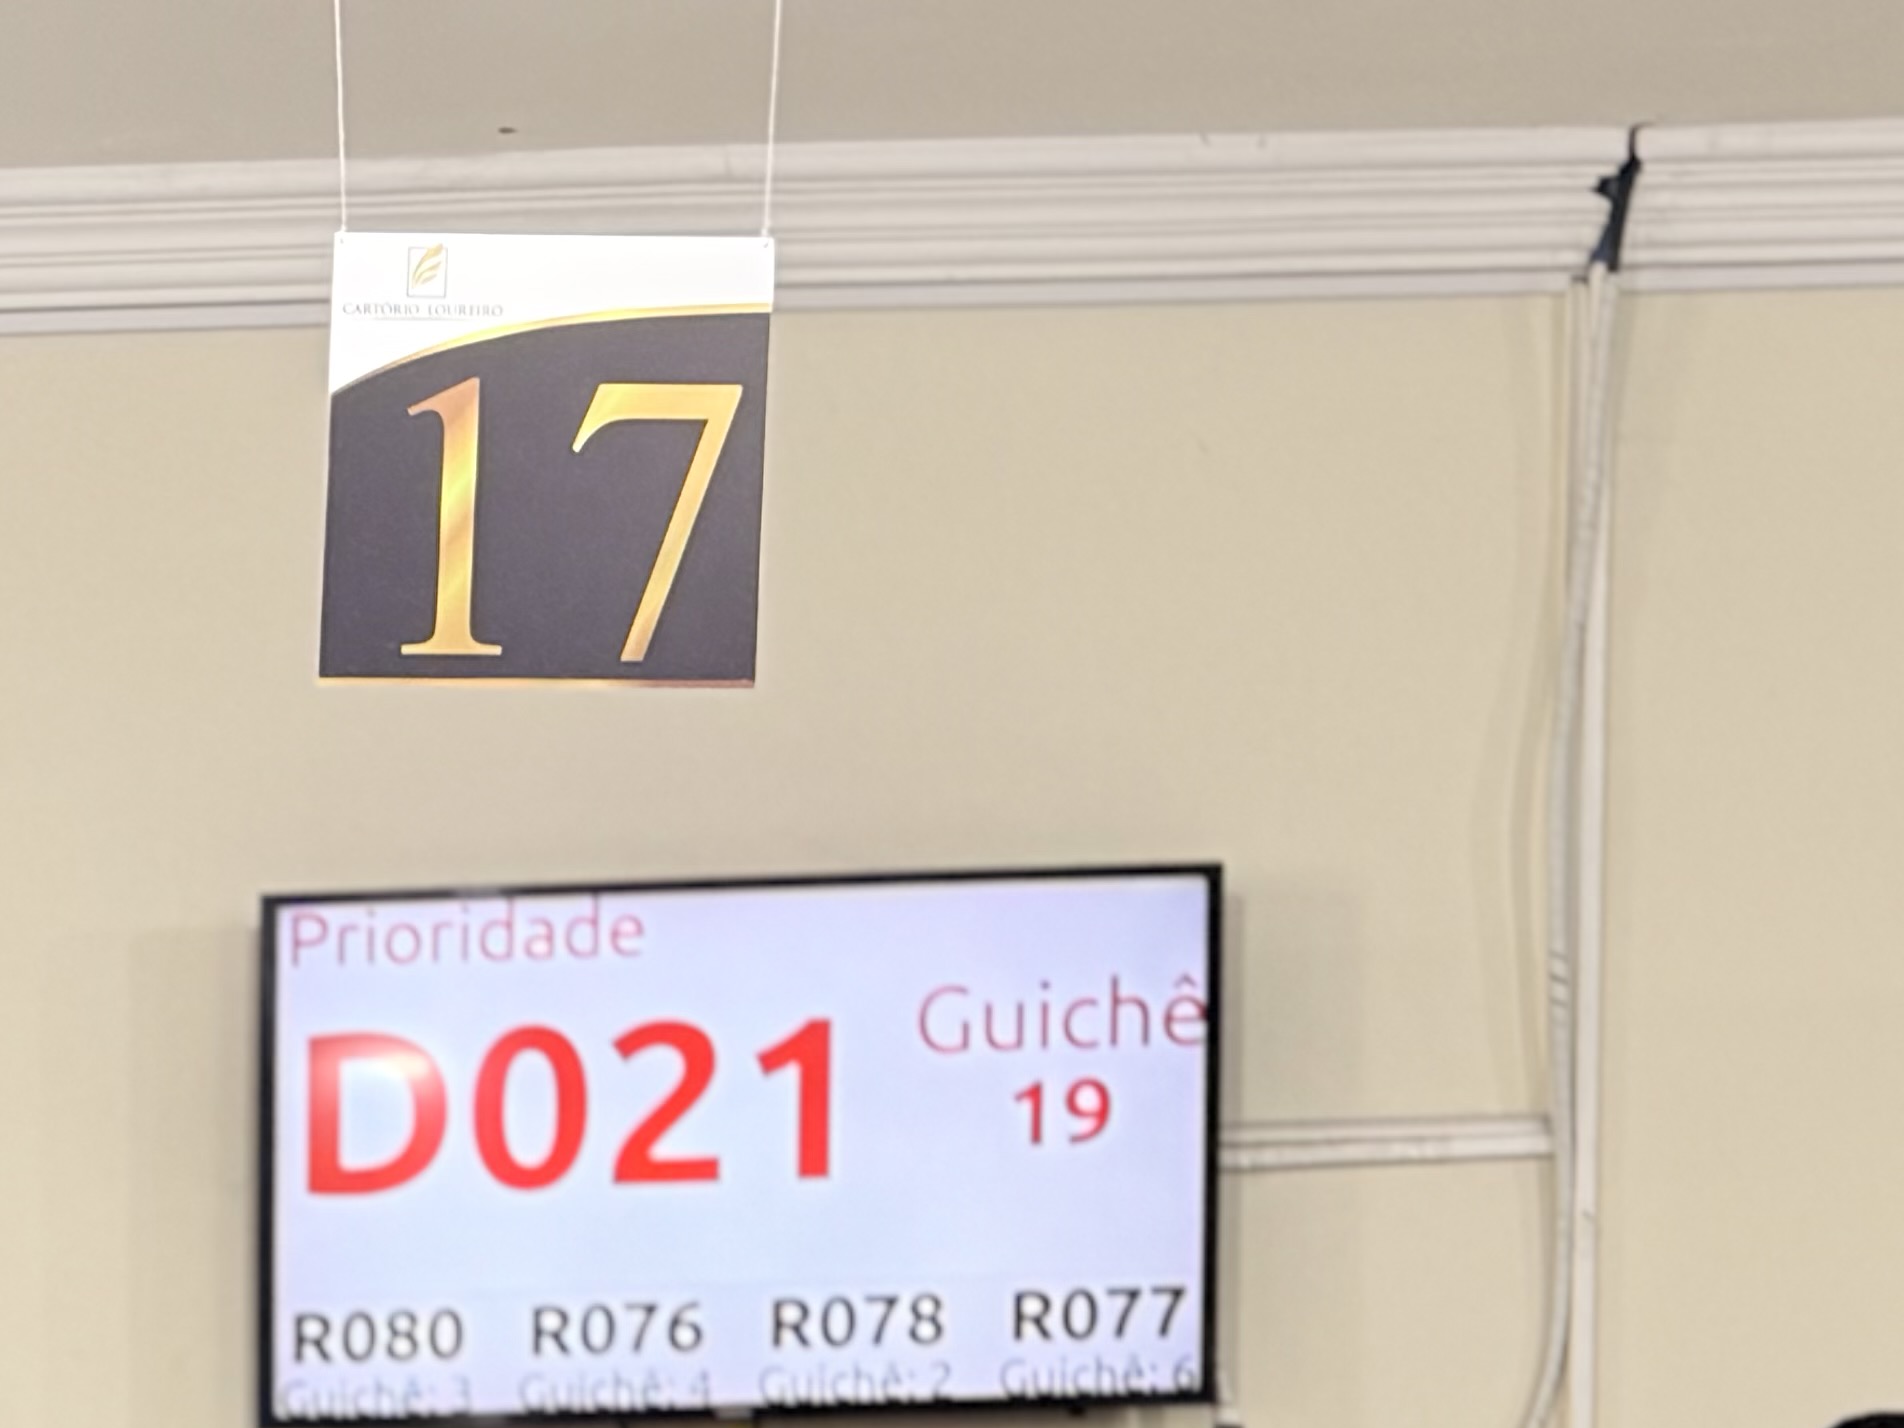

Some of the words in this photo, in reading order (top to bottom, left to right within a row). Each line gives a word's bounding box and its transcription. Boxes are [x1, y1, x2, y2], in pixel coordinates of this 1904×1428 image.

[400, 377, 744, 662] 17
[290, 895, 646, 966] Prioridade
[918, 975, 1207, 1054] Guichê
[307, 1017, 832, 1196] D021
[1013, 1078, 1112, 1146] 19
[293, 1308, 464, 1363] R080
[532, 1301, 704, 1356] R076
[771, 1293, 945, 1348] R078
[1013, 1285, 1187, 1341] R077
